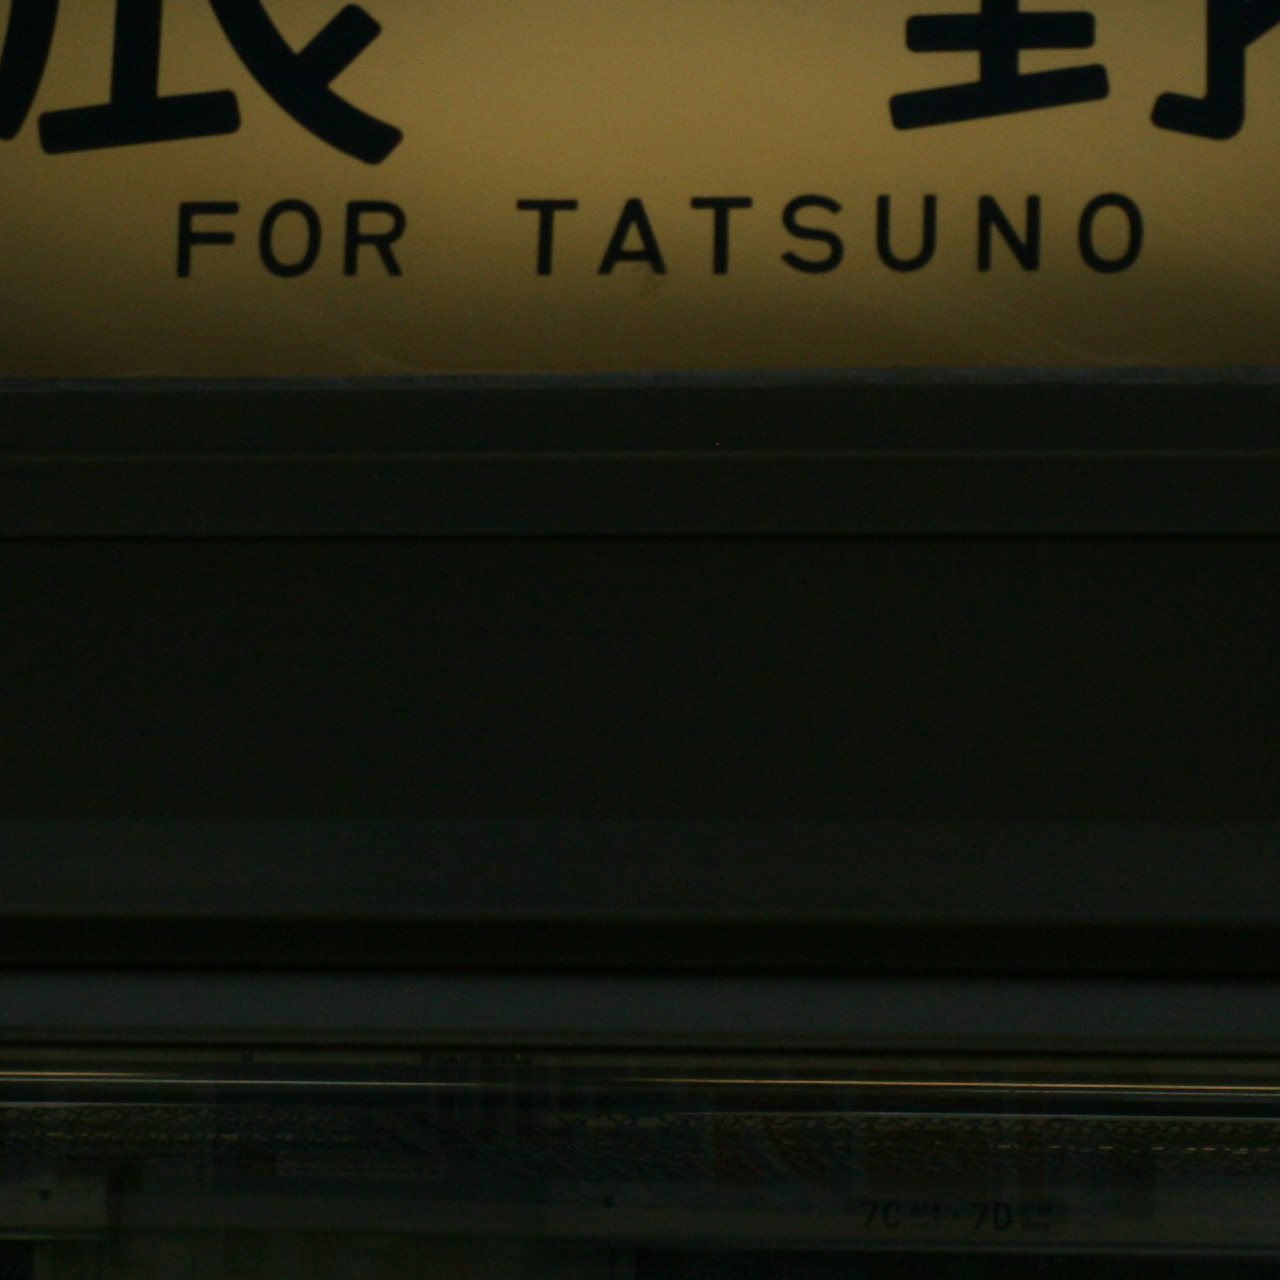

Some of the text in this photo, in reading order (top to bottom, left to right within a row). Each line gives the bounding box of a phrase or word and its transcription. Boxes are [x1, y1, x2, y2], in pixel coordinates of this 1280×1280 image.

[175, 193, 1145, 279] FOR TATSUNO
[861, 1200, 902, 1229] 7C
[970, 1202, 1013, 1231] 7D
